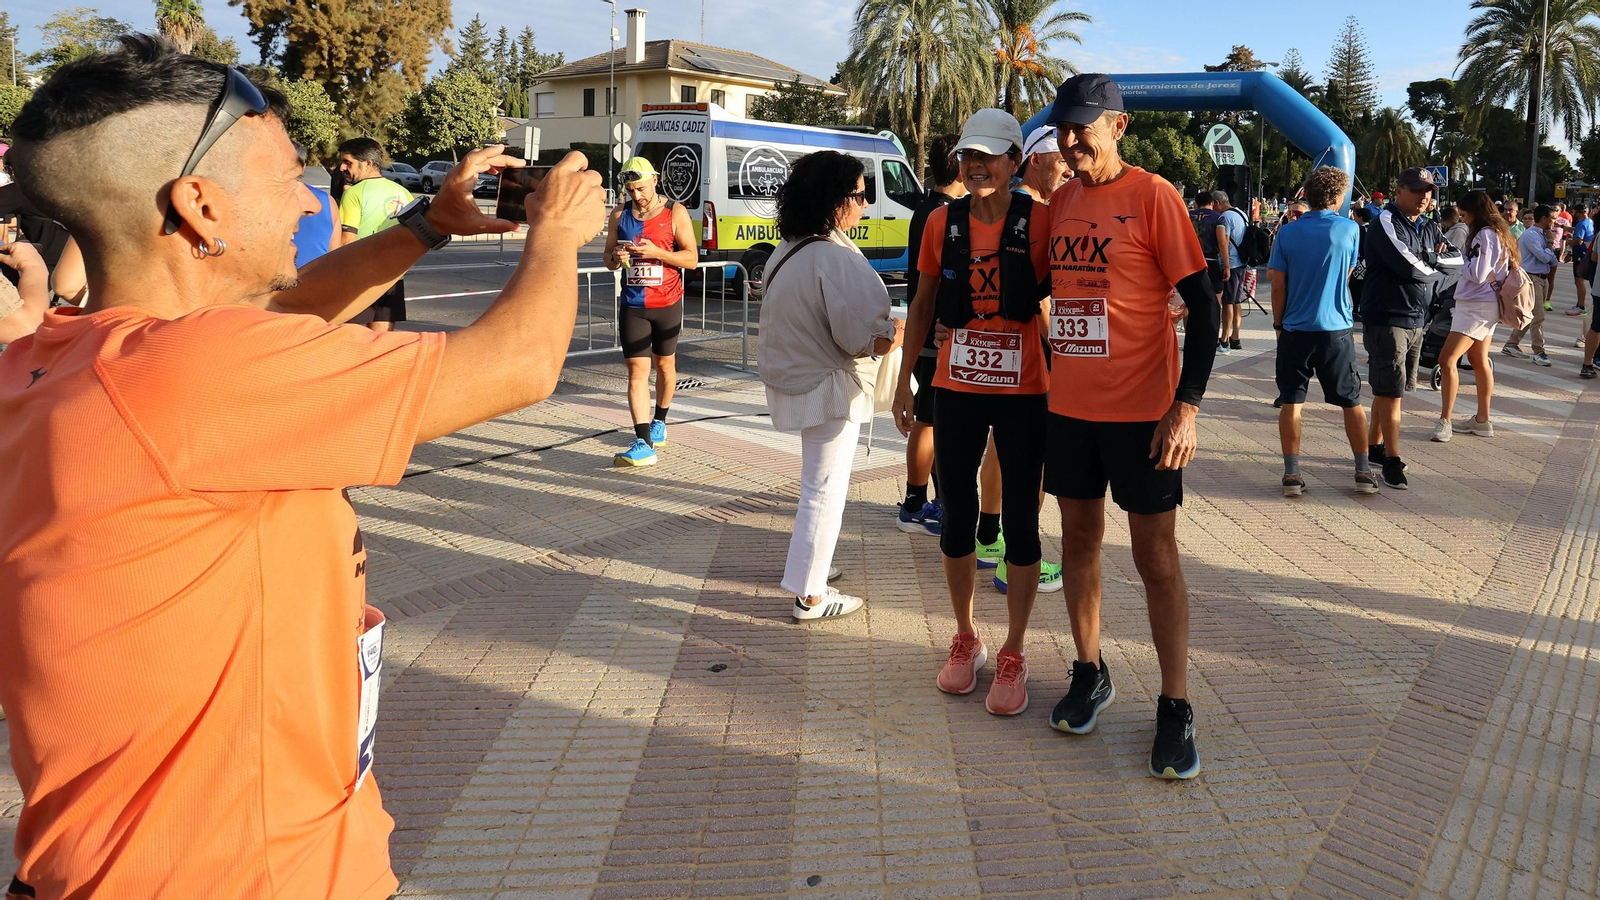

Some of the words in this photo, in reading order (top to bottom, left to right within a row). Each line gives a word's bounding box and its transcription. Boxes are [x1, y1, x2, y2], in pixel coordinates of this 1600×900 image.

[1117, 83, 1188, 91] Ayuntamiento
[1206, 82, 1237, 90] Jerez
[639, 120, 680, 132] AMBULANCIAS
[681, 121, 706, 133] CADIZ
[751, 165, 784, 174] AMBULANCIAS
[735, 225, 782, 240] AMBUL
[1005, 246, 1026, 254] KIPRUN
[633, 267, 652, 277] 211
[1057, 318, 1088, 337] 333
[965, 348, 1003, 369] 332
